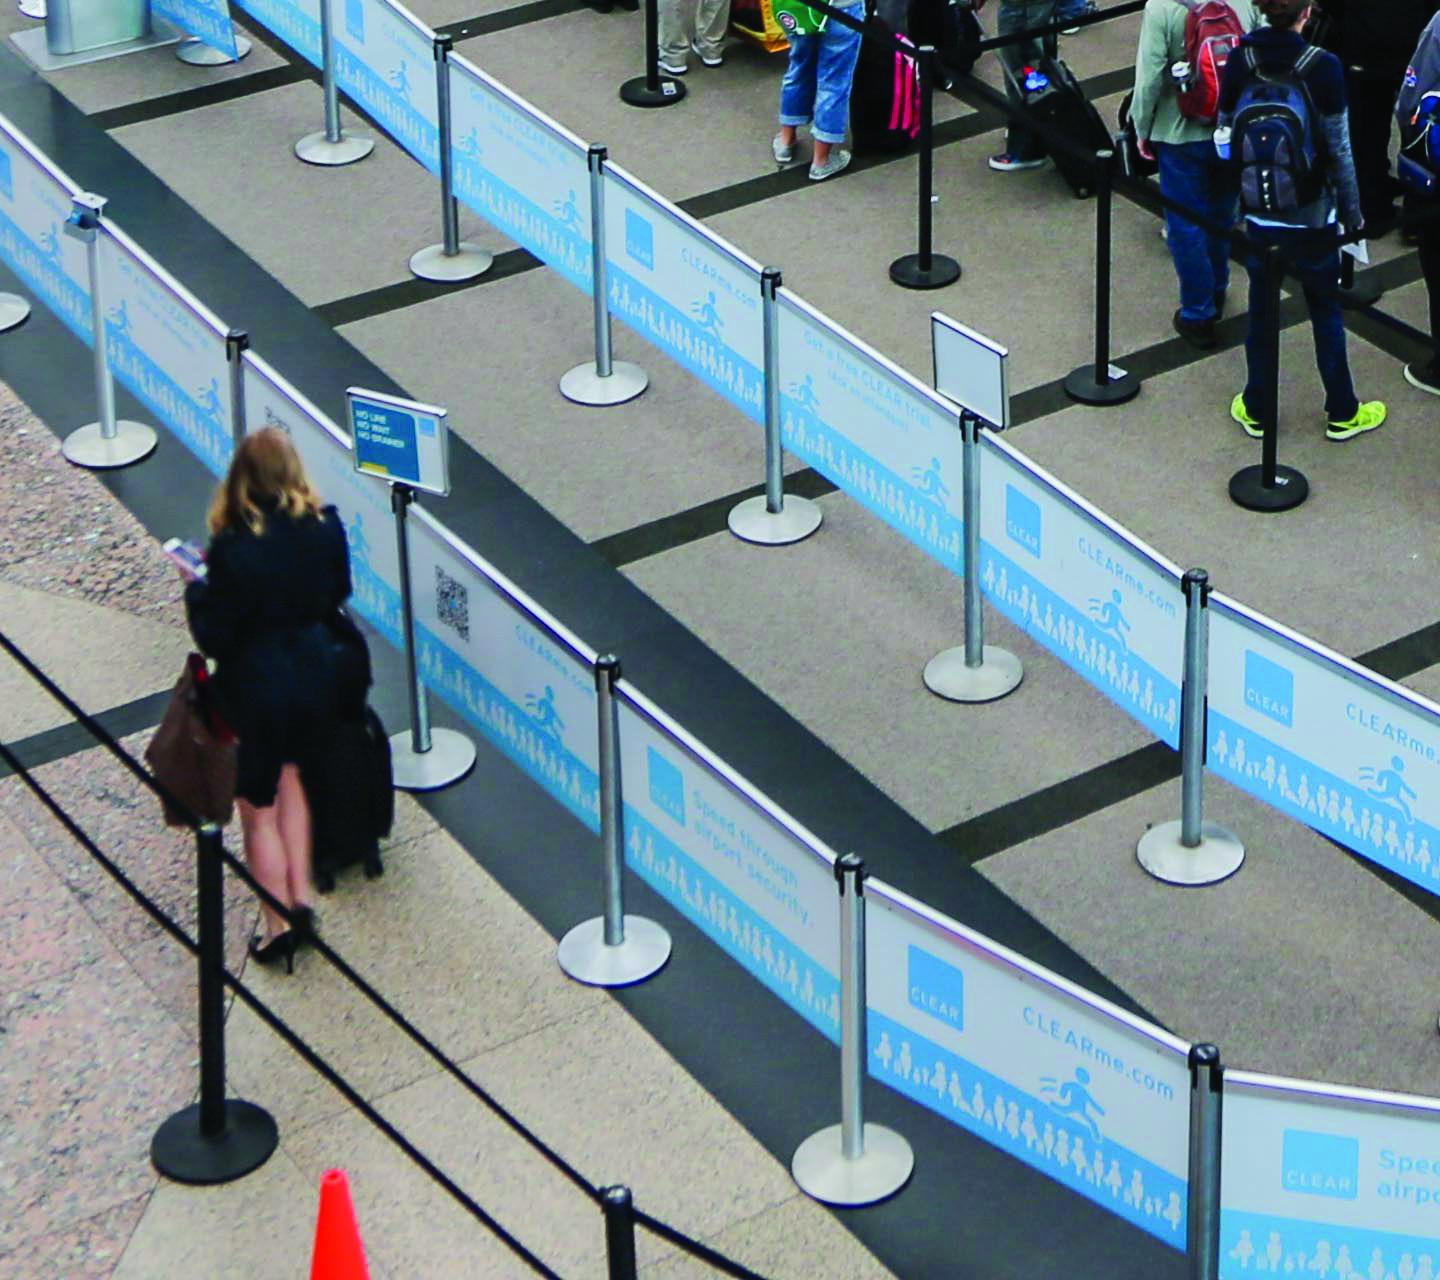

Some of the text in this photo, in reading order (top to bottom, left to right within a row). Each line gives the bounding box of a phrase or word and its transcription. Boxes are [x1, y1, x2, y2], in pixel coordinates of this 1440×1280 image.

[860, 369, 902, 410] CLEAR
[903, 399, 933, 429] trial
[1006, 518, 1040, 549] CLEAR
[1077, 536, 1178, 617] CLEARme.com
[1244, 683, 1291, 722] CLEAR
[692, 786, 800, 891] Speed through
[693, 819, 813, 928] airport security.
[910, 983, 961, 1021] CLEAR
[1022, 1003, 1176, 1102] CLEARme.com
[1284, 1167, 1354, 1195] CLEAR
